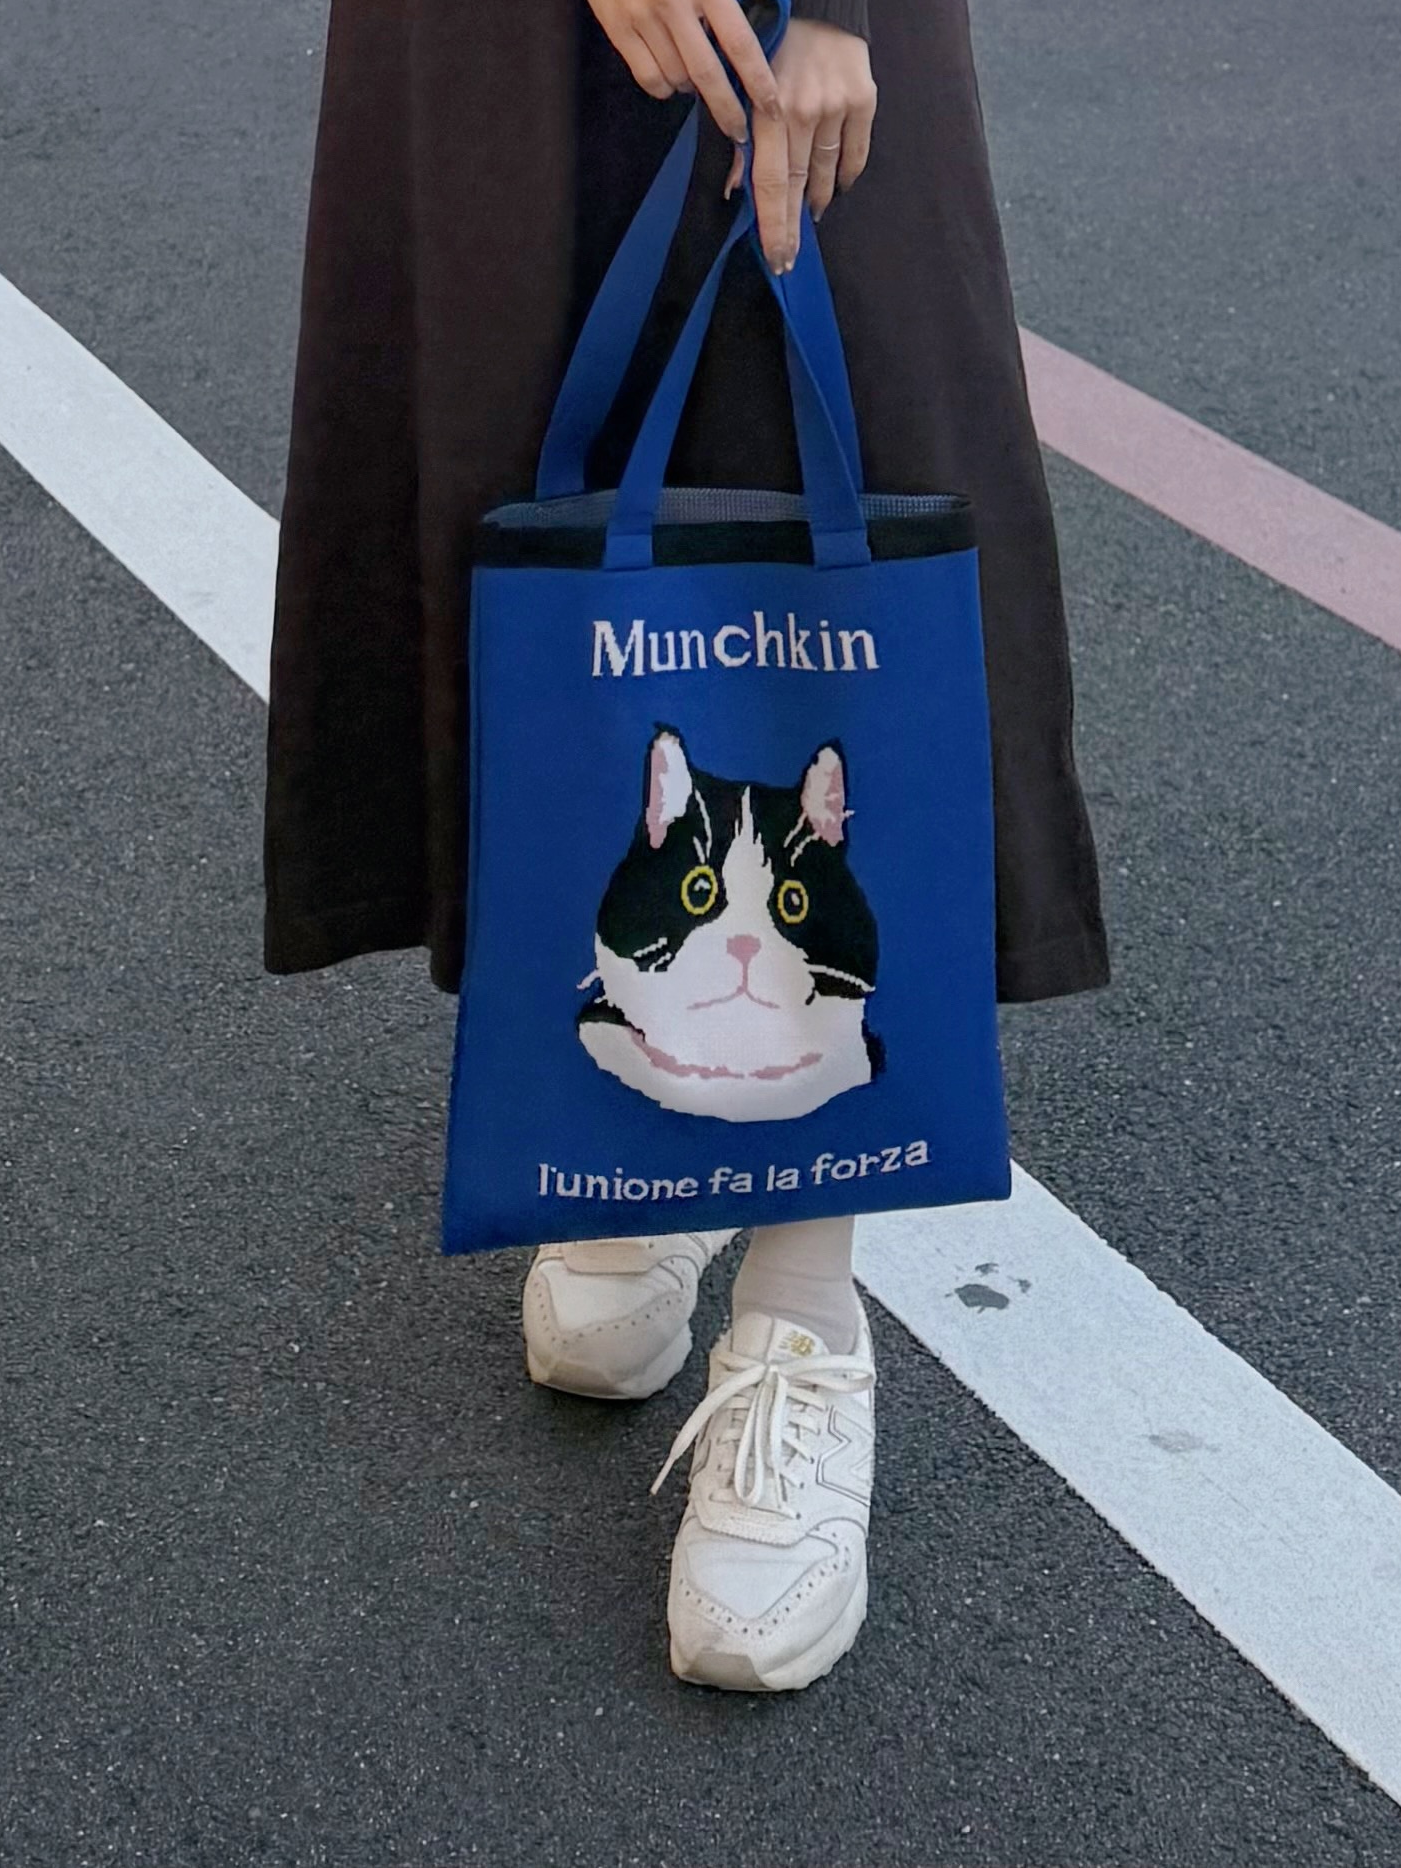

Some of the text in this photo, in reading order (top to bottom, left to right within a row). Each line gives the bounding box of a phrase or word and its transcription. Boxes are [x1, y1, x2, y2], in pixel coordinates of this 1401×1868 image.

[591, 611, 879, 677] Munchkin
[708, 1167, 753, 1194] fa
[765, 1164, 800, 1192] la
[810, 1140, 929, 1186] forza
